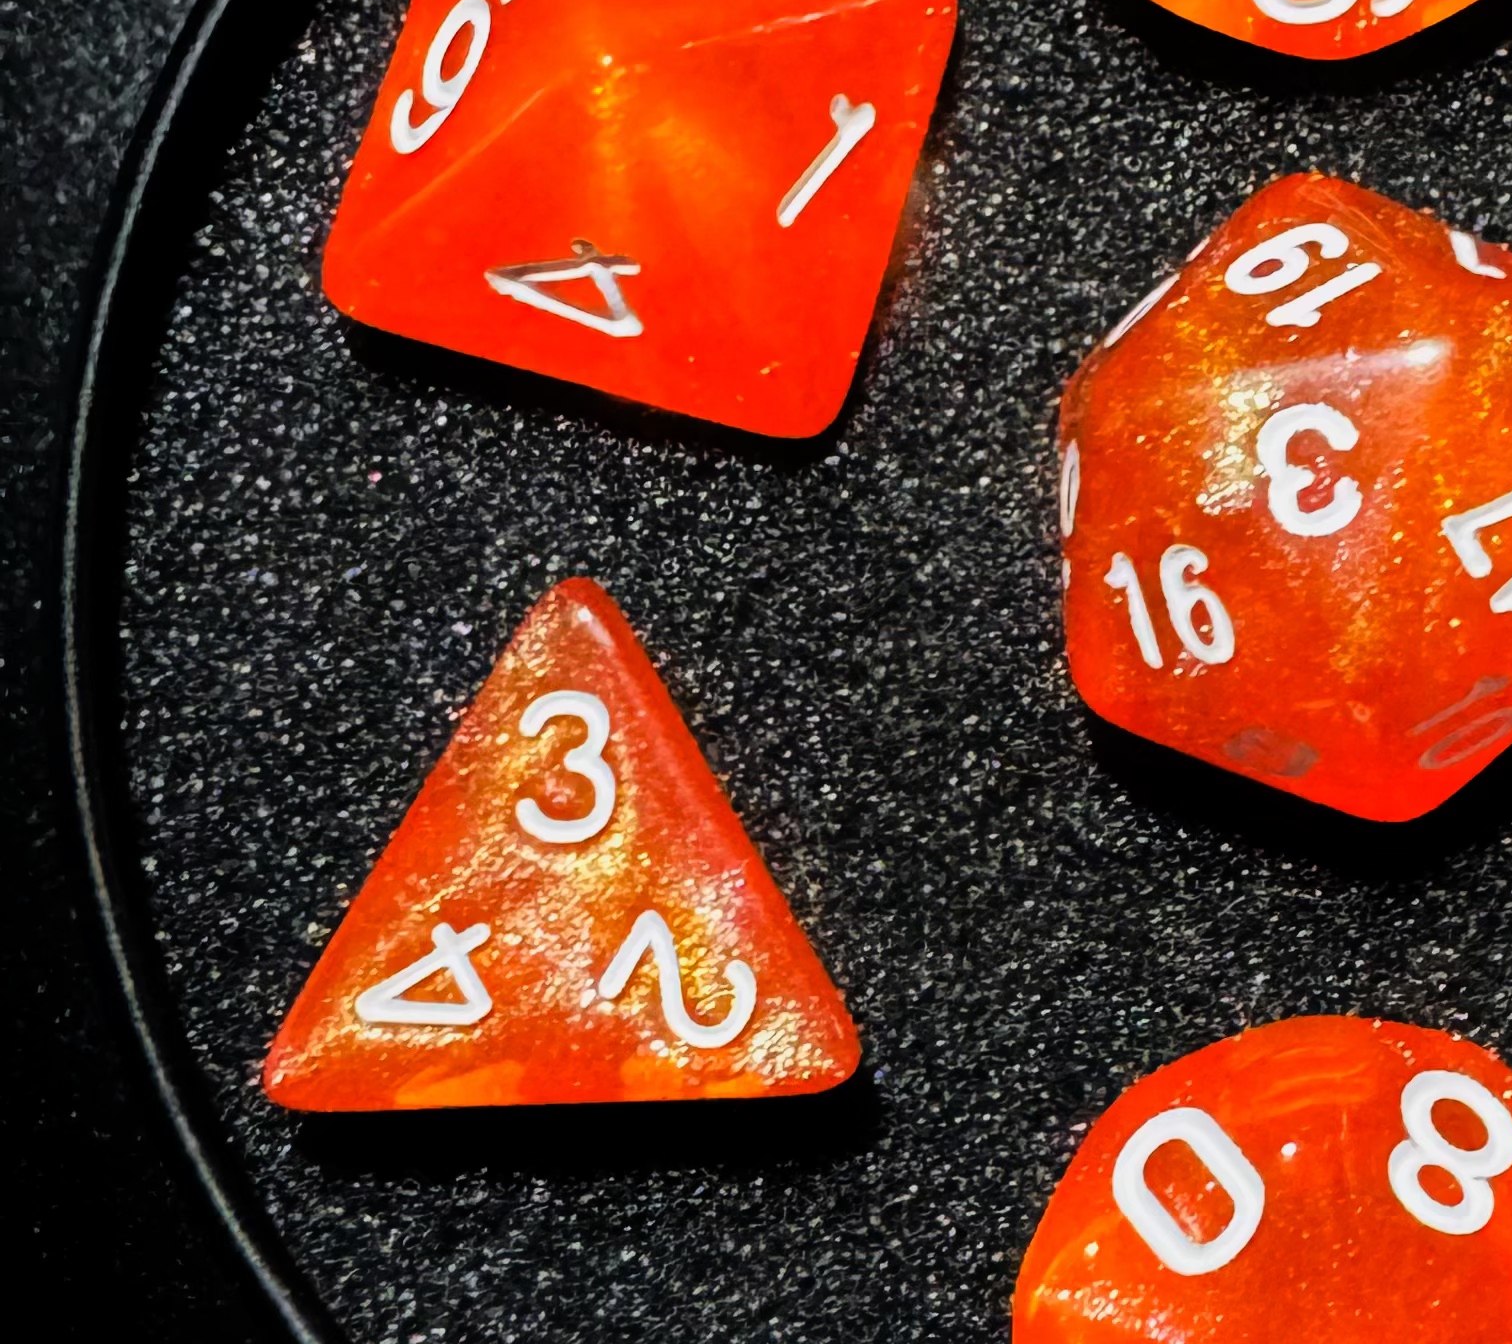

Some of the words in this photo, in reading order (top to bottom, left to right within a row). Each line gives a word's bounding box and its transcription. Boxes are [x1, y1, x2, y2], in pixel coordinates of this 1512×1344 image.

[776, 93, 876, 229] 1
[484, 239, 644, 337] 4
[1224, 223, 1382, 327] 19
[1257, 403, 1362, 537] 3
[1104, 544, 1235, 669] 16
[515, 690, 616, 843] 3
[355, 922, 492, 1025] 4
[600, 910, 757, 1048] 2
[1112, 1107, 1265, 1276] 0
